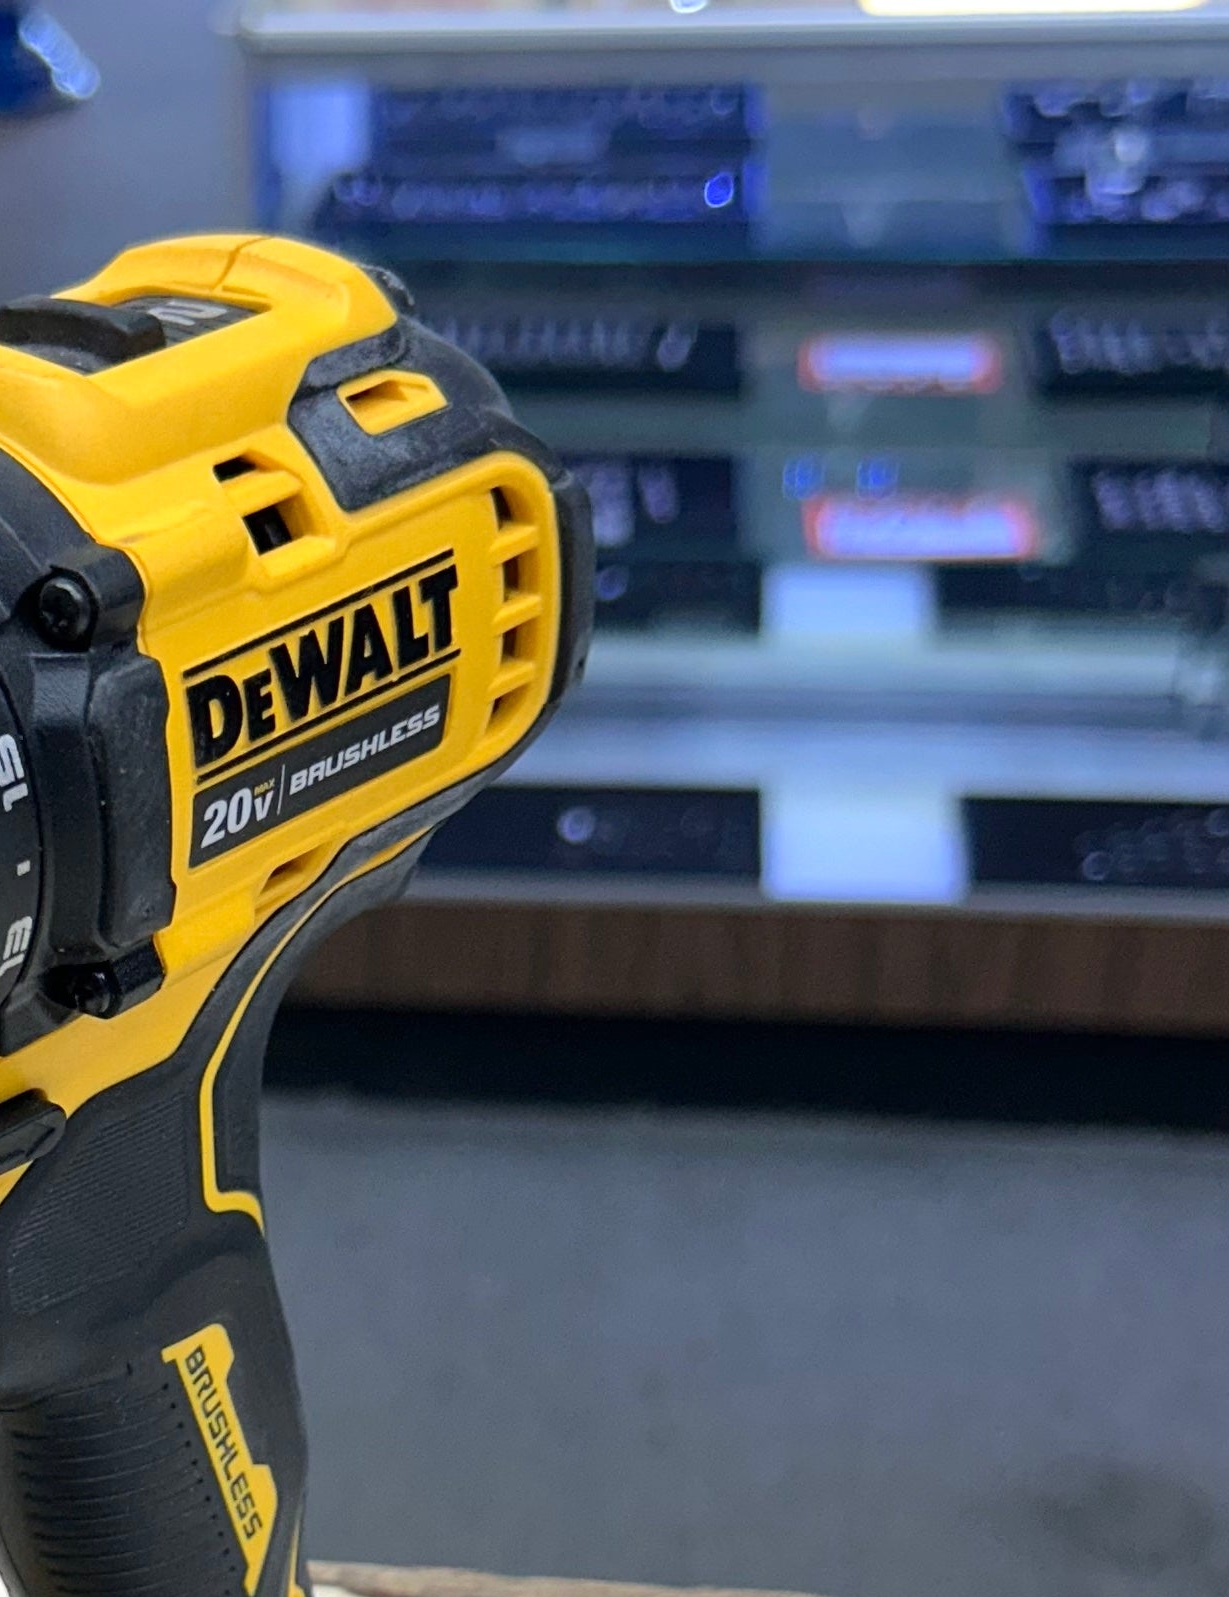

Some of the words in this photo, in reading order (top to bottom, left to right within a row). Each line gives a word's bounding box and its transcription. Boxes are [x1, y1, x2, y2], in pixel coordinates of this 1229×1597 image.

[186, 563, 458, 769] DEWALT
[289, 704, 439, 796] BRUSHLESS
[185, 1345, 263, 1540] BRUSHLESS
